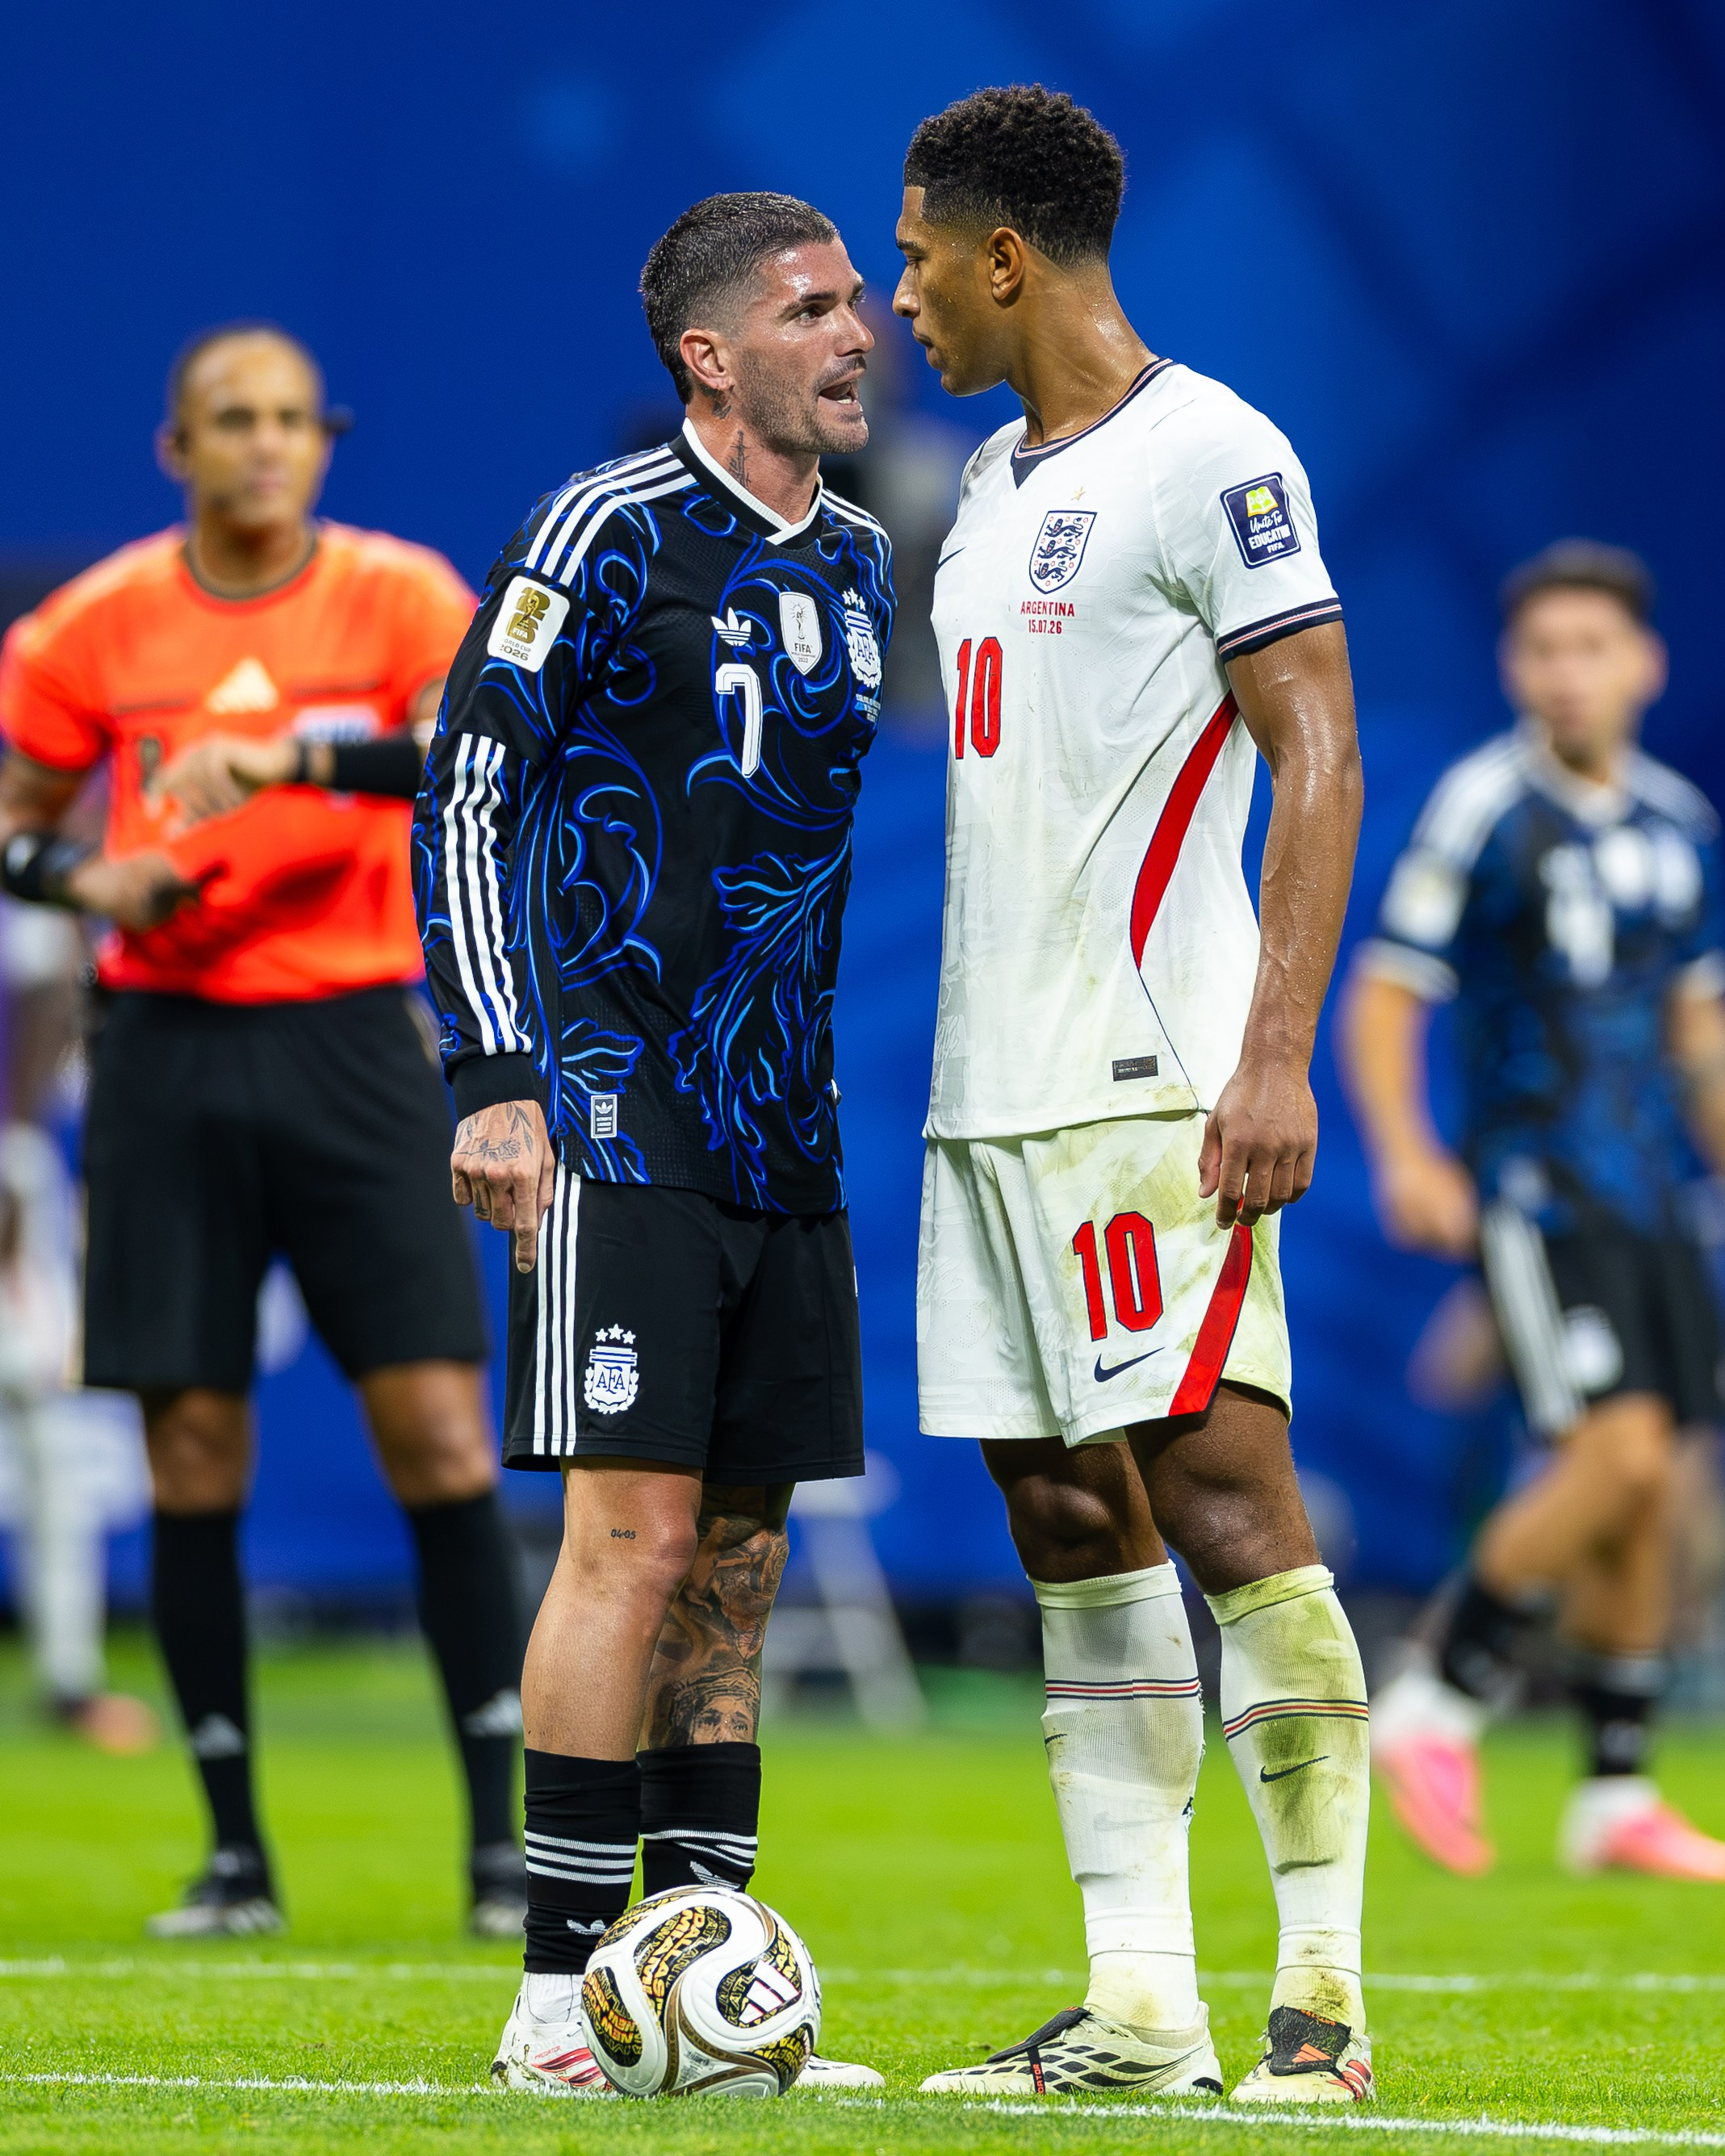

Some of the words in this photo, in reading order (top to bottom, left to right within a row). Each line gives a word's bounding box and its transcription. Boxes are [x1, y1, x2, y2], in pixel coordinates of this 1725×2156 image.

[1267, 542, 1285, 554] FIFA
[1020, 601, 1075, 617] ARGENTINA
[1028, 619, 1062, 634] 15.07.26
[504, 638, 519, 649] ORLD
[794, 643, 811, 654] FIFA
[955, 636, 1003, 760] 10
[715, 664, 763, 778] 7
[1072, 1210, 1164, 1343] 10
[597, 1364, 626, 1395] AFA
[652, 1912, 705, 1998] DALLAS
[601, 2016, 633, 2044] NEW
[1033, 2063, 1045, 2095] DATOR
